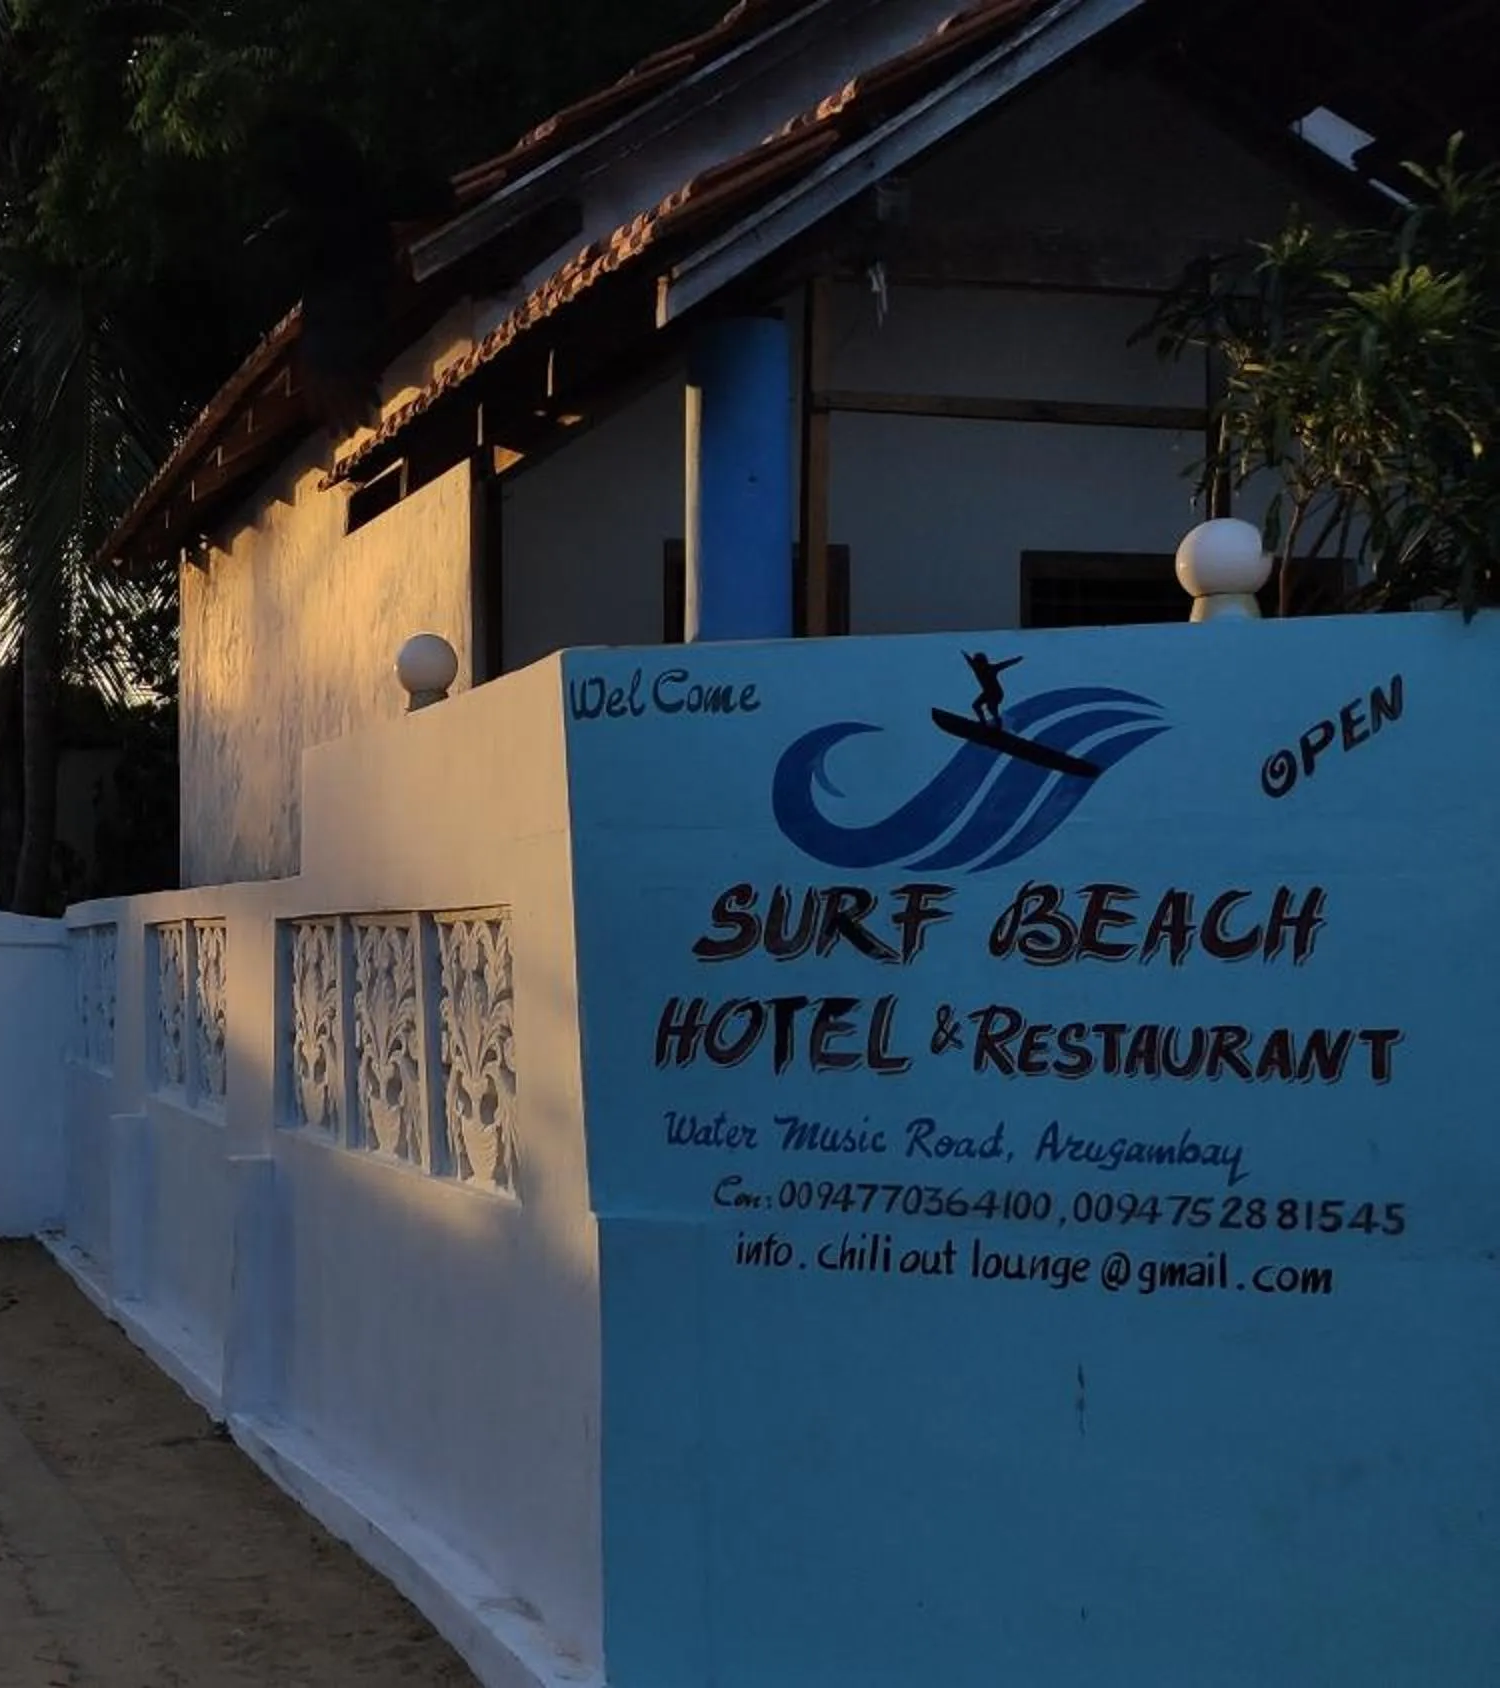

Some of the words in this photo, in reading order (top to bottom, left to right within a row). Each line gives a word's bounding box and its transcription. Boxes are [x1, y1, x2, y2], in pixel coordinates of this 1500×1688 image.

[1261, 674, 1404, 799] OPEN
[692, 883, 956, 967] SURF
[988, 880, 1328, 967] BEACH
[655, 994, 913, 1076] HOTEL
[930, 1004, 966, 1056] &
[967, 1004, 1406, 1086] RESTAURANT
[664, 1111, 757, 1149] Water
[774, 1114, 886, 1154] Music
[906, 1118, 1014, 1163] Road,
[1034, 1120, 1250, 1187] Arugambay
